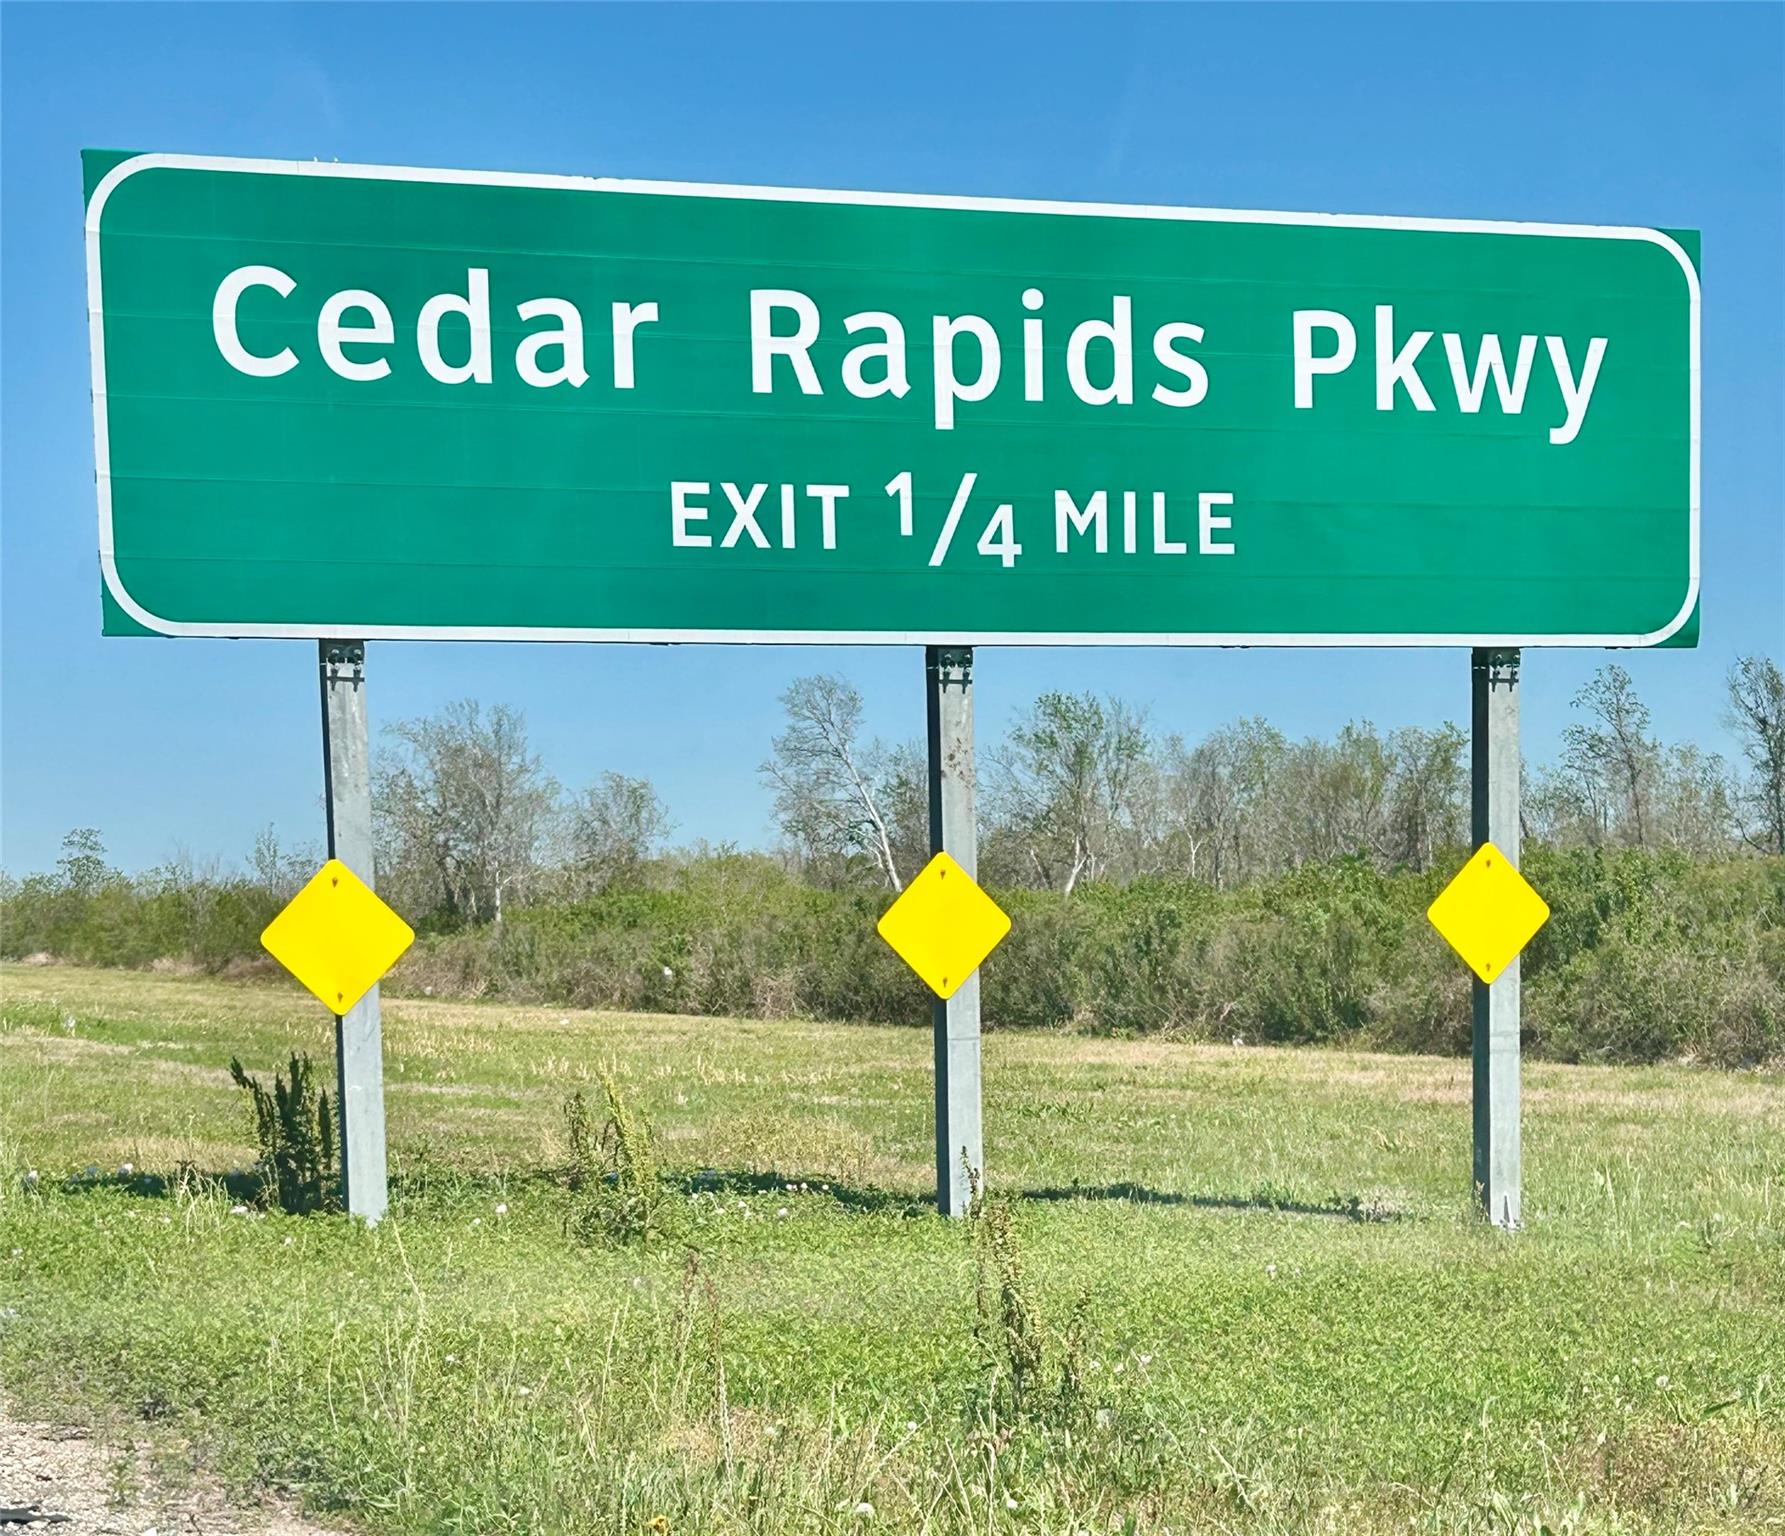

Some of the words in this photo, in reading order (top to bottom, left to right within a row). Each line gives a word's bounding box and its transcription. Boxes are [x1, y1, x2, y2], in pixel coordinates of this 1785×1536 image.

[212, 265, 659, 389] Cedar
[750, 288, 1209, 430] Rapids
[1293, 305, 1608, 445] Pkwy
[671, 481, 850, 550] EXIT
[884, 471, 1022, 568] 1/4
[1054, 489, 1235, 555] MILE
